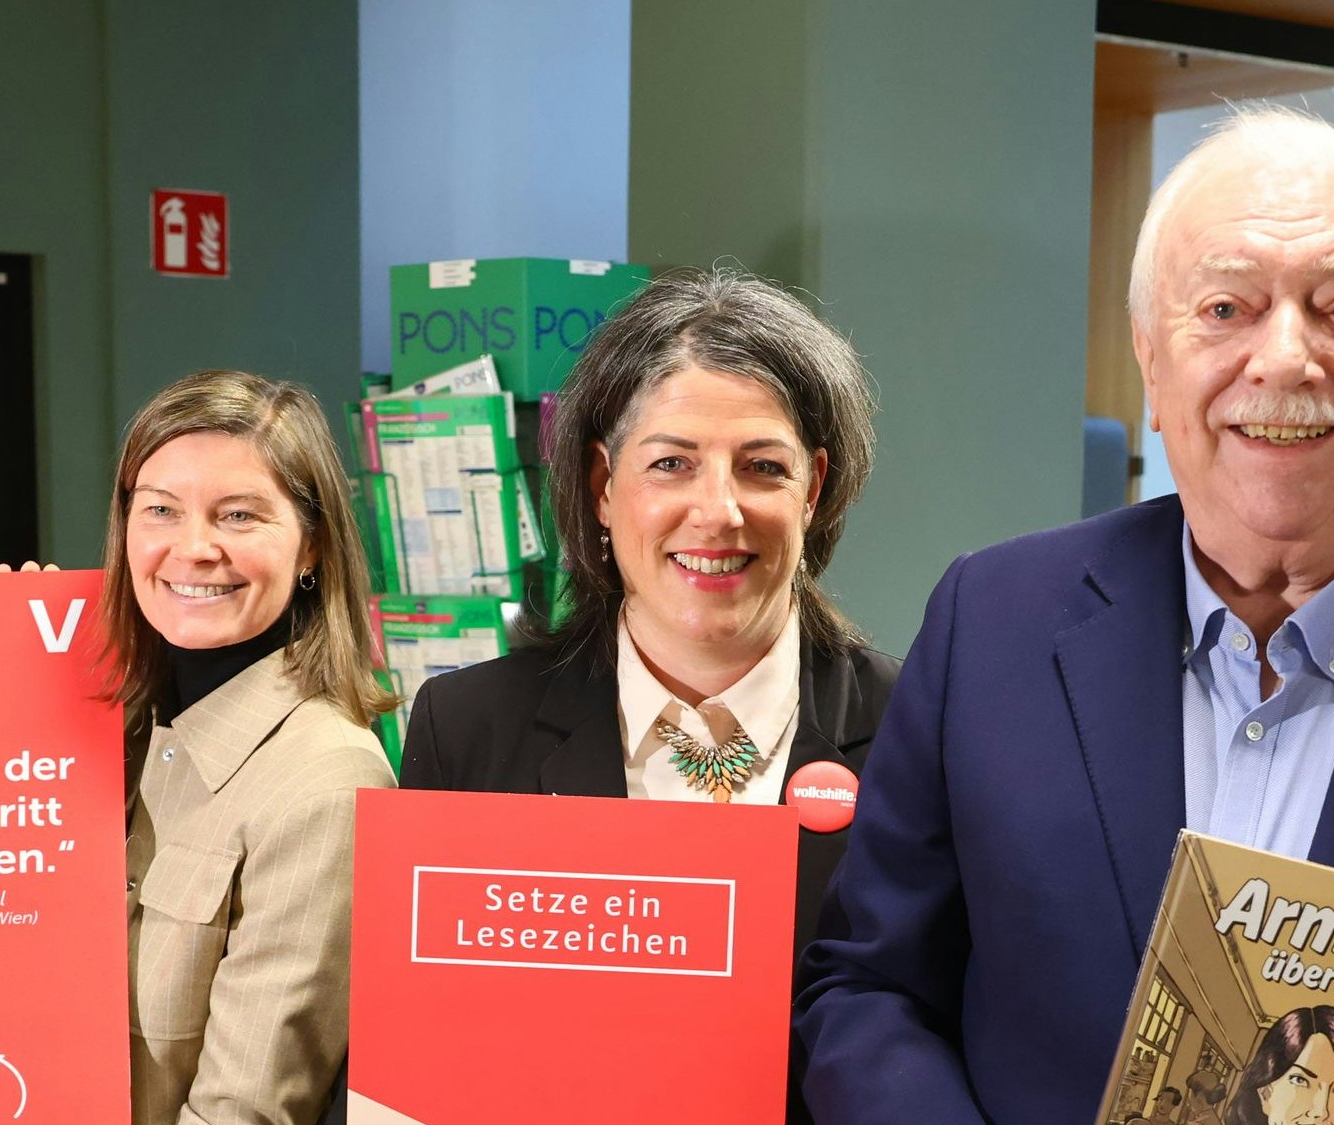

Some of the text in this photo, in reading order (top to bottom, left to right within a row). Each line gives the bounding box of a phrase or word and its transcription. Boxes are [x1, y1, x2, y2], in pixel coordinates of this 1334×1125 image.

[399, 306, 517, 354] PONS
[534, 306, 604, 352] PO
[28, 599, 86, 652] V
[5, 750, 75, 781] der
[793, 786, 857, 802] volkshilfe.
[485, 884, 661, 918] Setze ein
[457, 920, 687, 955] Lesezeichen
